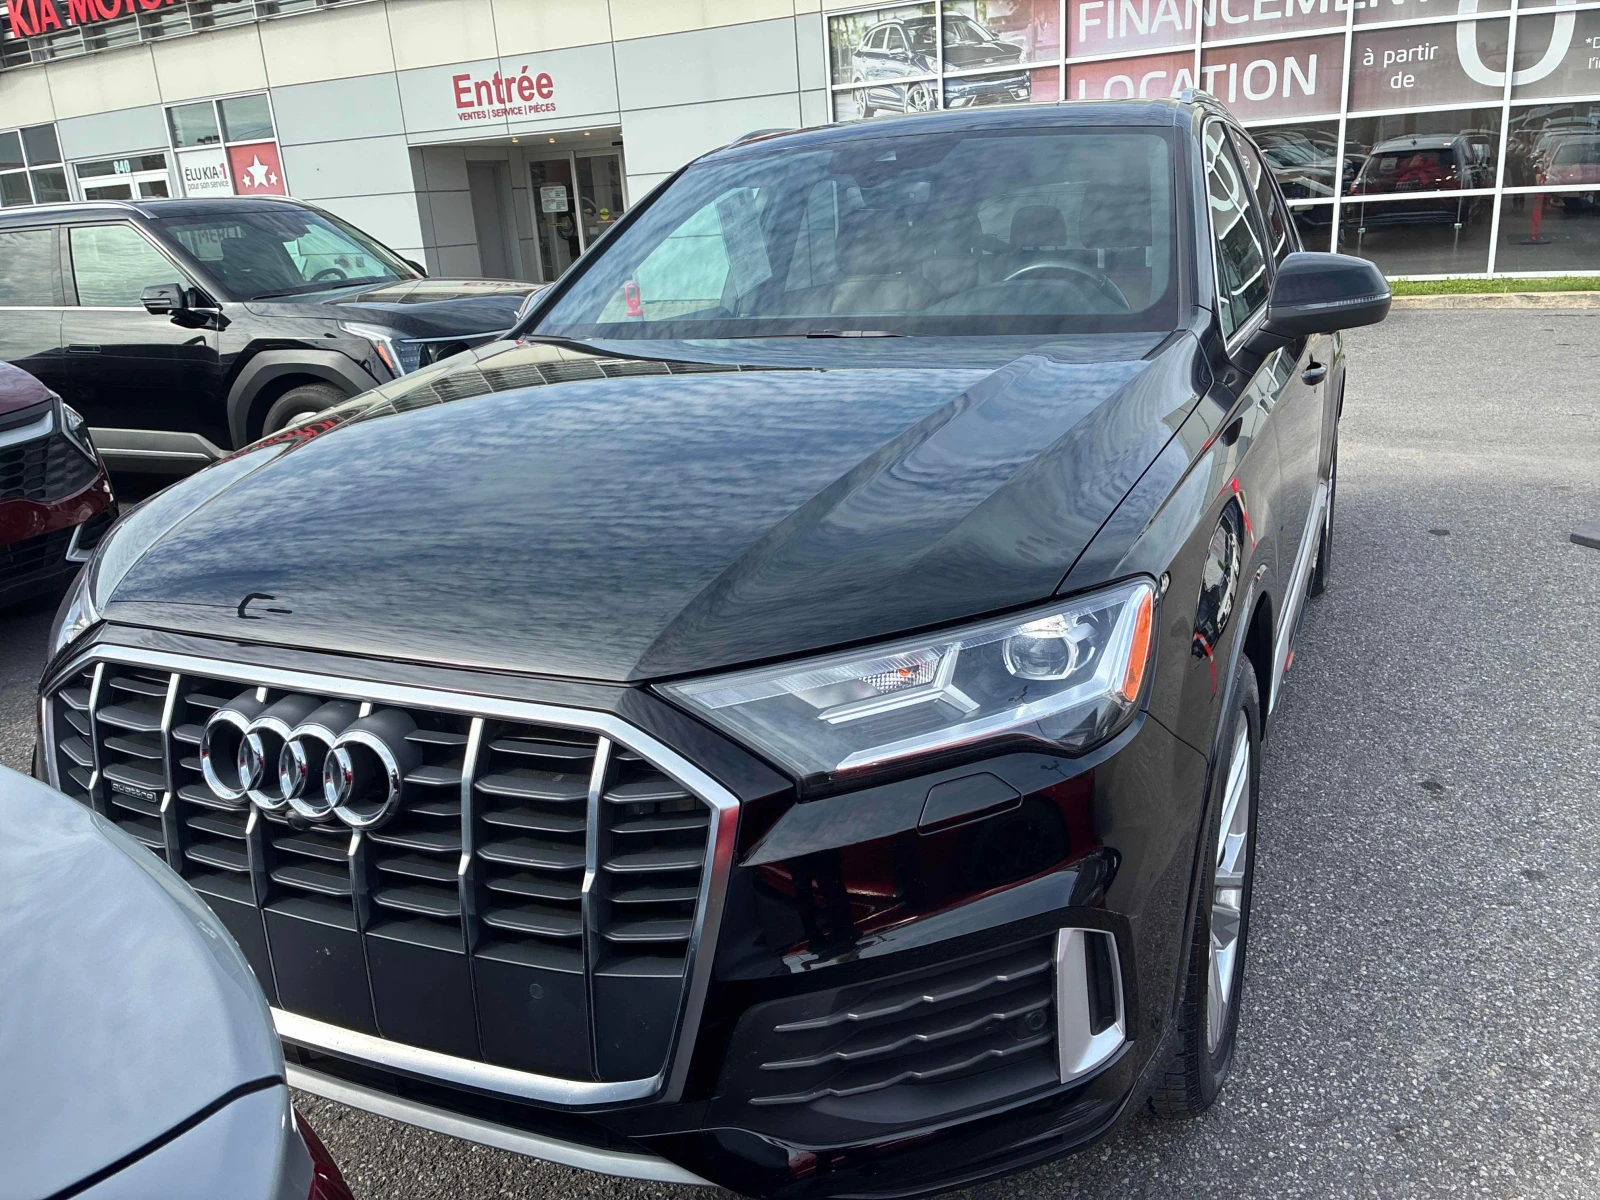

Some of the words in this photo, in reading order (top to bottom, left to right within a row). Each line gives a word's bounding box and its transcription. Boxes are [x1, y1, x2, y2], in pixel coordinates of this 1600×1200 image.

[7, 0, 62, 38] KIA
[1079, 0, 1428, 42] FINANCE
[1363, 48, 1374, 66] à
[1383, 43, 1439, 68] partir
[452, 65, 554, 109] Entrée
[1390, 71, 1415, 89] de
[458, 110, 487, 121] VENTES
[491, 106, 524, 118] SERVICE
[528, 102, 556, 113] PIÈCES
[202, 166, 220, 180] KIA
[112, 783, 153, 800] quattro
